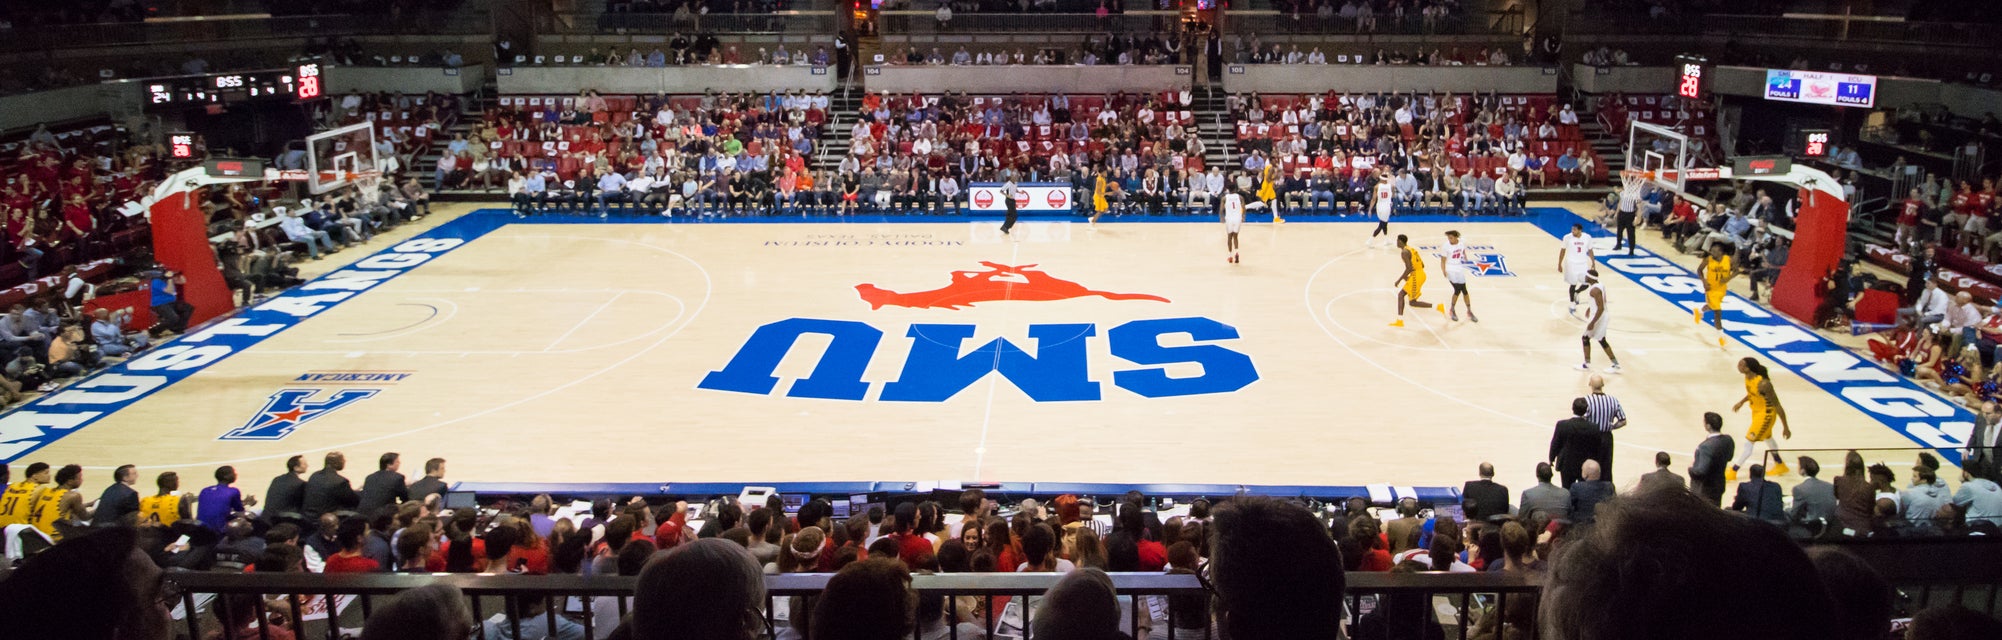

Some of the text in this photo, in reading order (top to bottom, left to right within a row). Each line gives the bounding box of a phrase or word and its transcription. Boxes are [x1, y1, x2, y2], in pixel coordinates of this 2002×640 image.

[299, 77, 318, 97] 28
[1681, 76, 1698, 97] 28
[1848, 84, 1858, 94] 11
[153, 92, 171, 103] 24
[1837, 95, 1860, 103] FOULS
[0, 237, 464, 460] MUSTANGS
[696, 316, 1261, 402] SMU
[294, 373, 412, 381] AMERICAN
[0, 497, 19, 516] 31
